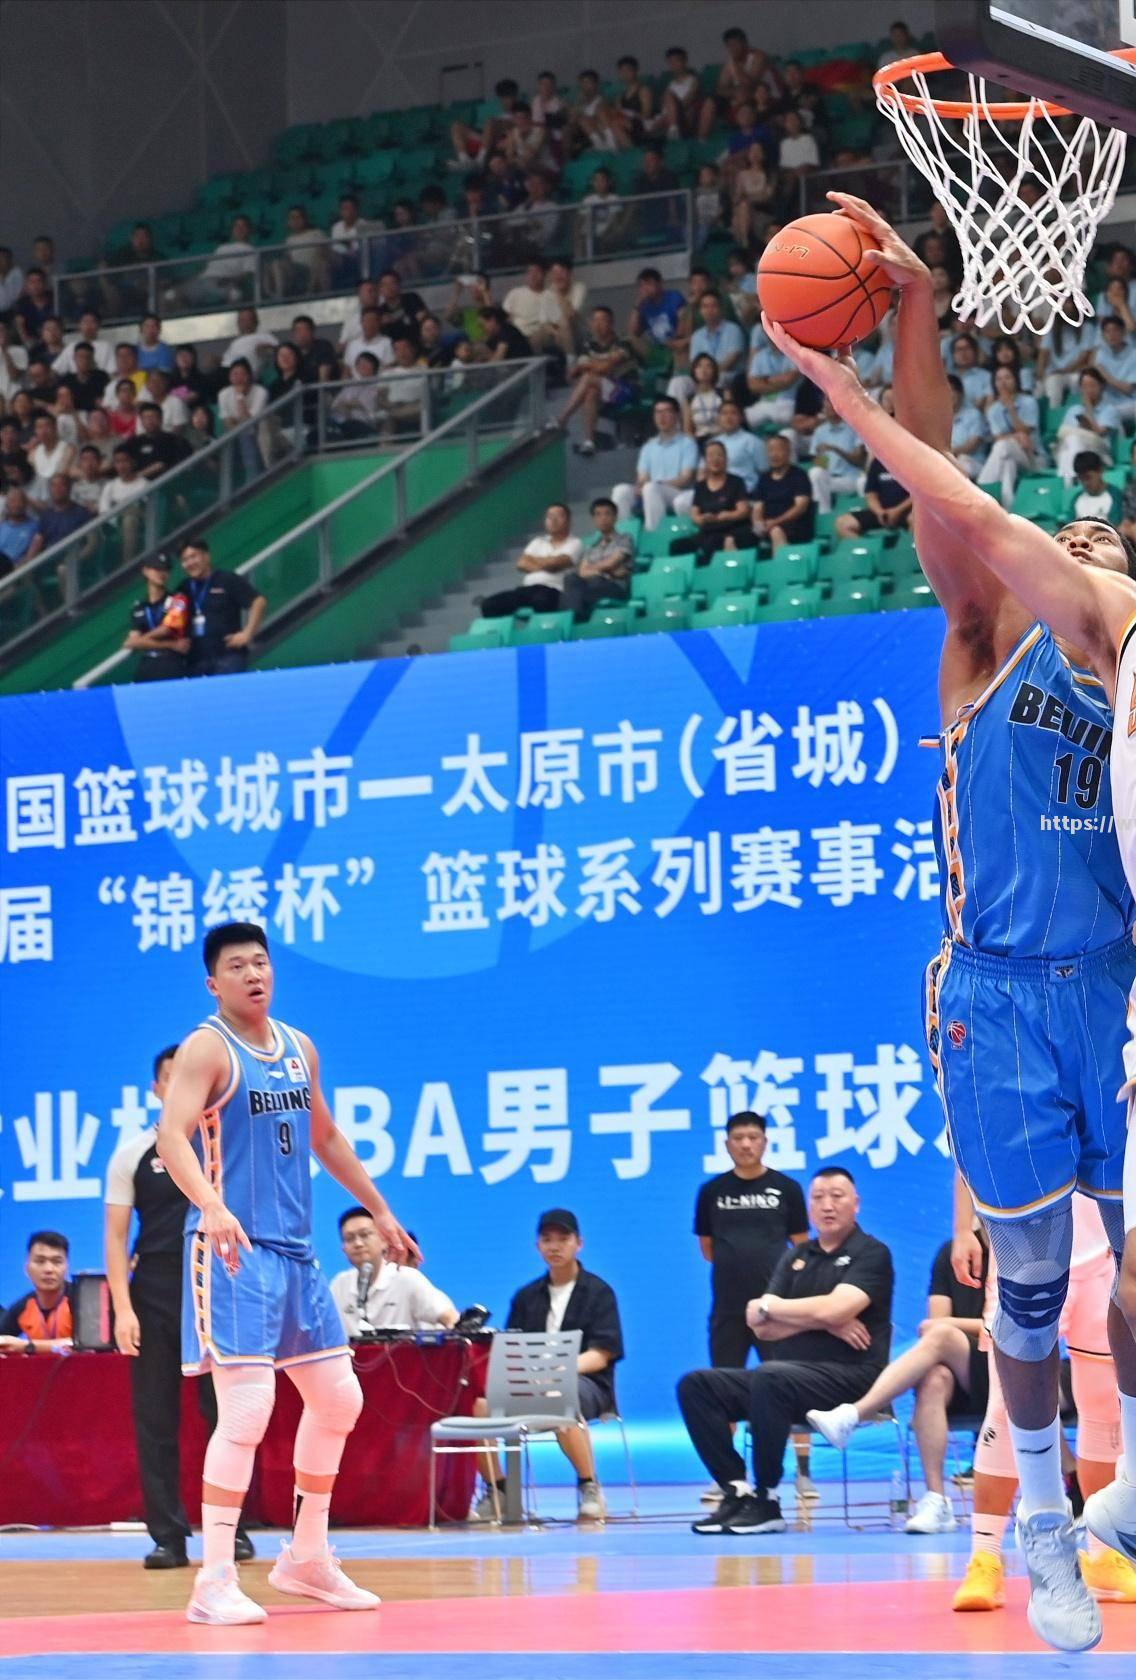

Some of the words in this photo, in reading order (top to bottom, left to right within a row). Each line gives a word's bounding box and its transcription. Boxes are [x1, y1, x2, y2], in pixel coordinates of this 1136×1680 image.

[1054, 752, 1103, 809] 19
[249, 1086, 312, 1115] BEIJING
[279, 1121, 293, 1156] 9
